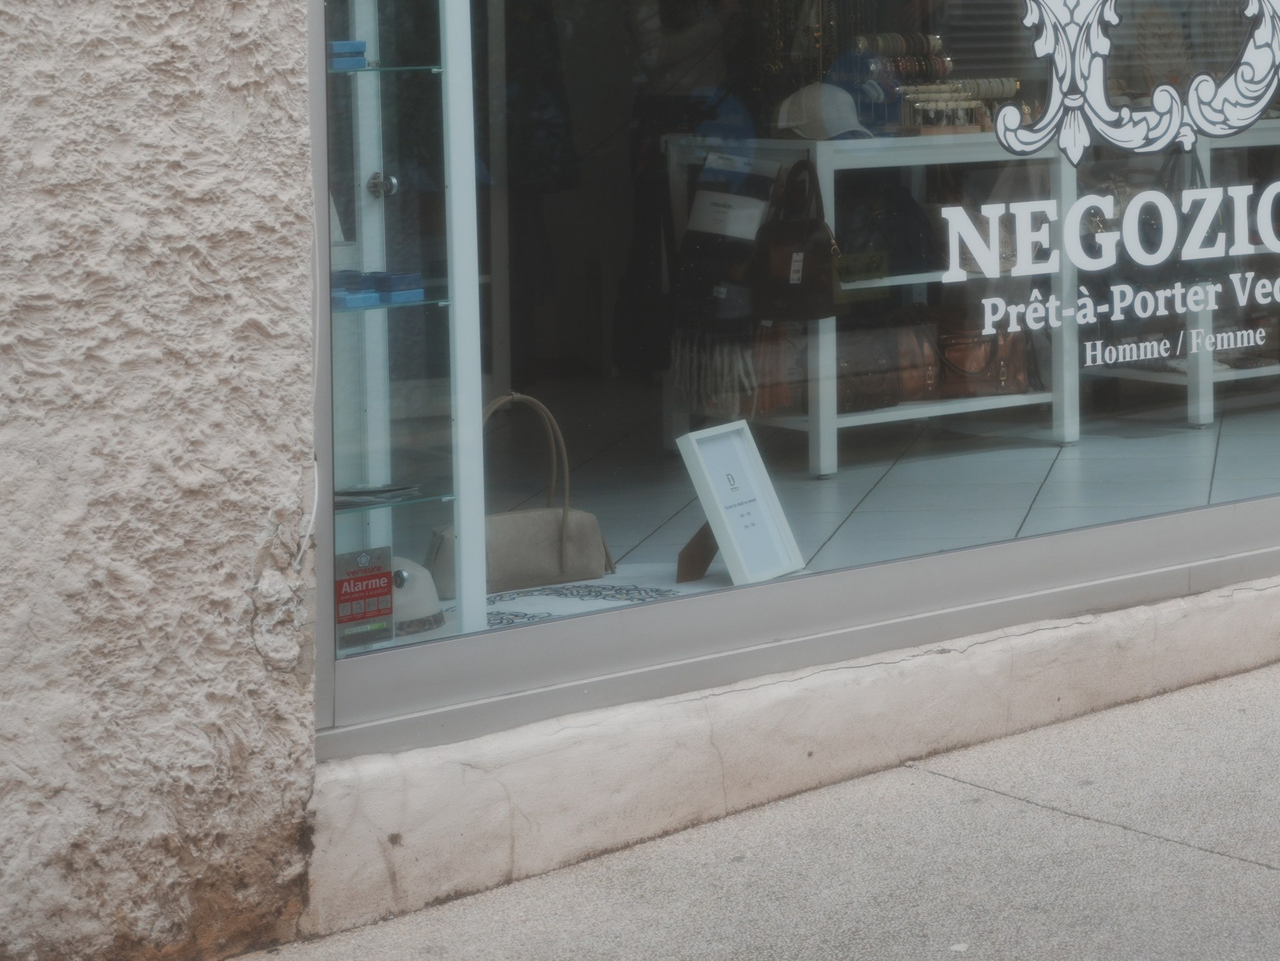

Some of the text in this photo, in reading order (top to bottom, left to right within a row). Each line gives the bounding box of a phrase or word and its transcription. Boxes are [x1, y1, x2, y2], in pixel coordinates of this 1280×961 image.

[981, 281, 1222, 335] Prêt-à-Porter
[1084, 327, 1266, 367] Homme / Femme
[341, 576, 388, 595] Alarme
[346, 565, 382, 577] verisure
